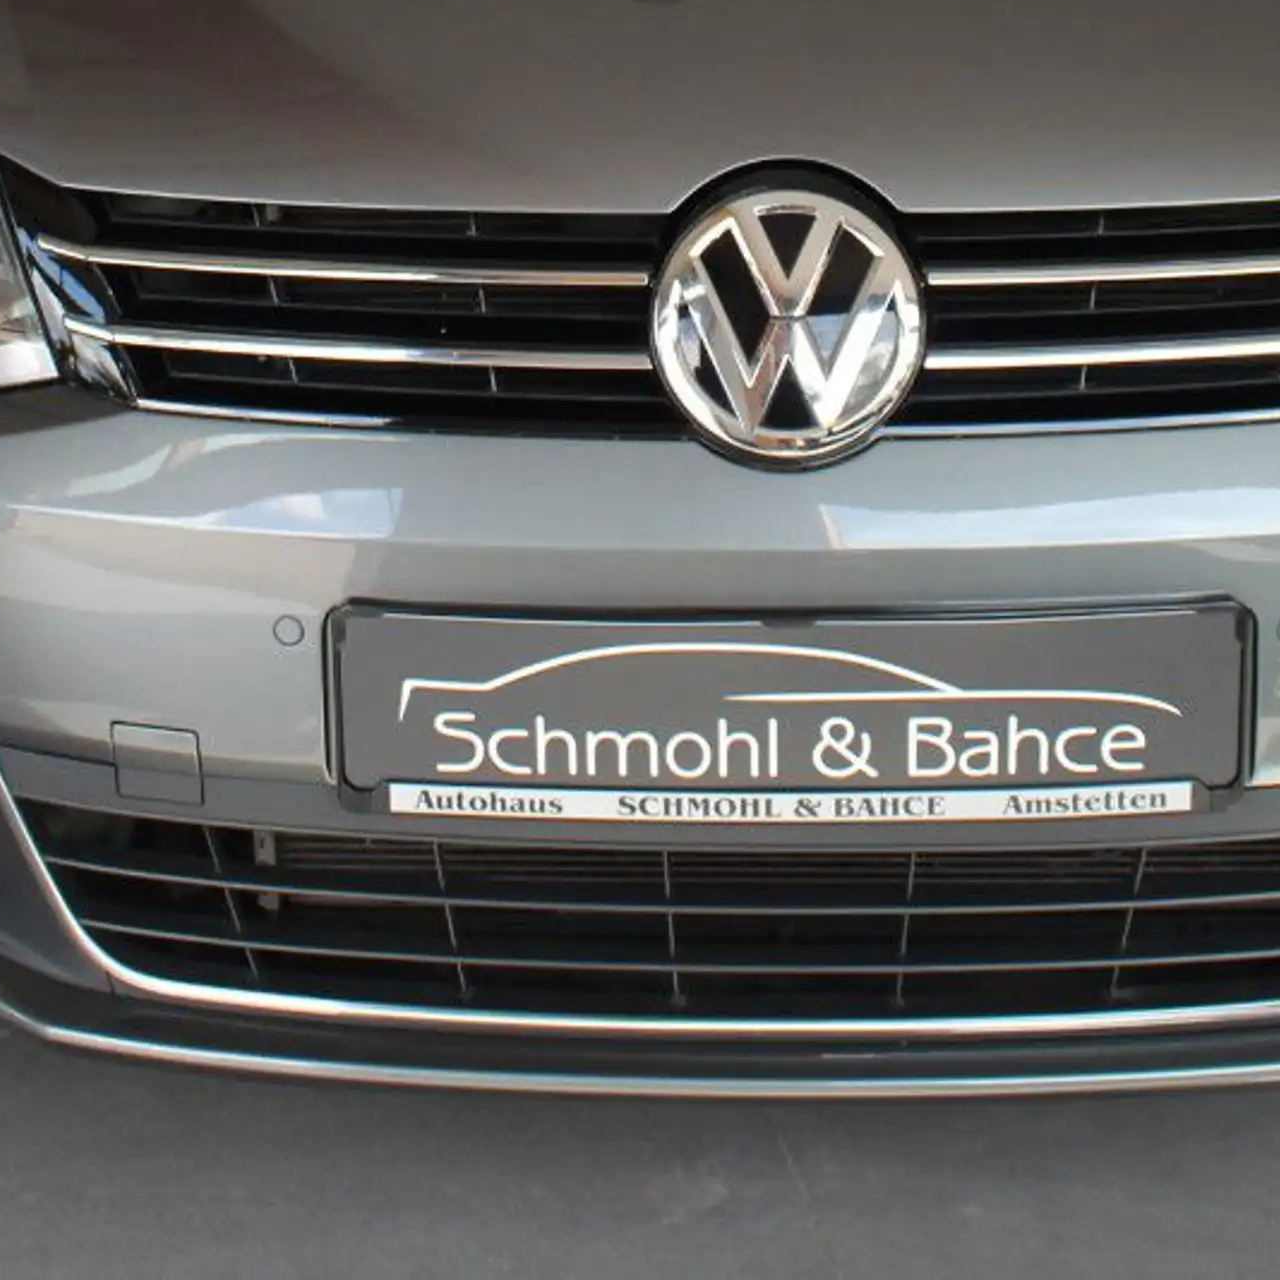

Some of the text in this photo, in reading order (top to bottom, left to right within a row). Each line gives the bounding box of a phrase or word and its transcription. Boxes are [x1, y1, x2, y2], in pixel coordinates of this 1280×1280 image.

[433, 711, 1147, 779] Schmohl & Bahce
[415, 789, 1169, 819] Autohaus SCHMOHL & BAHCE Amstetten
